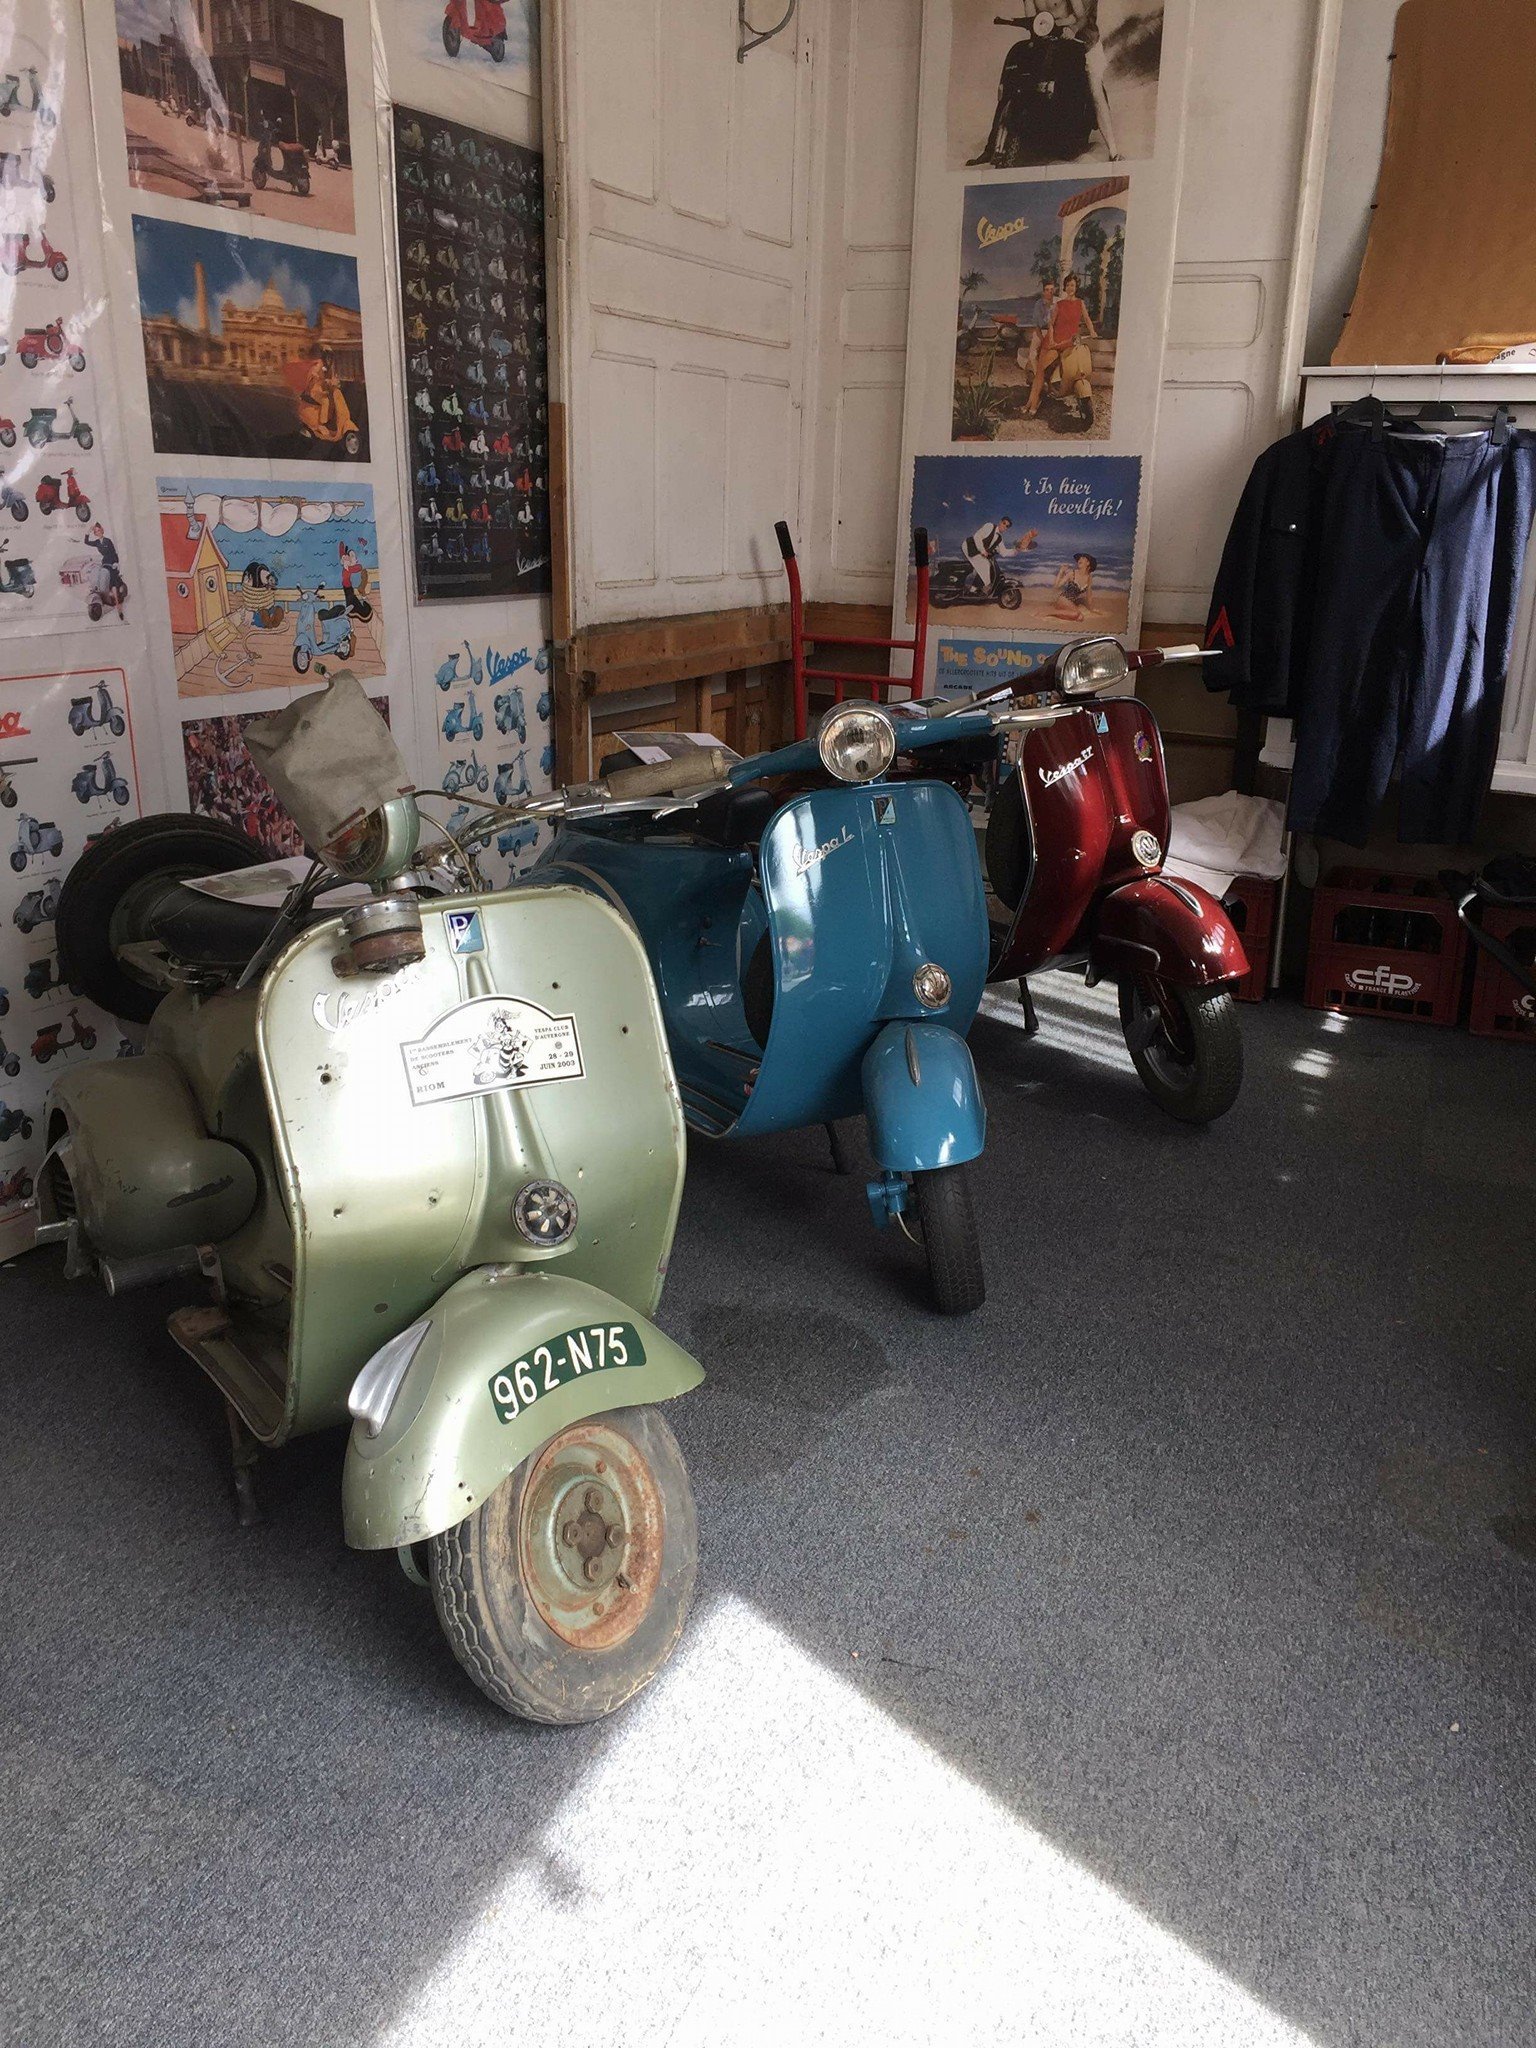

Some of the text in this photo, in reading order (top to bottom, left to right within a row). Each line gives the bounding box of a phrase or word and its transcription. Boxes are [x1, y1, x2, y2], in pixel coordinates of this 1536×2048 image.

[976, 216, 1029, 249] Vespa
[1059, 477, 1092, 495] hier
[1048, 497, 1123, 520] heerlijk!
[486, 645, 533, 687] Vespa
[940, 646, 968, 667] THE
[973, 646, 1033, 668] SOUND
[1038, 758, 1083, 788] Vespa
[792, 838, 843, 876] Vespa
[540, 1059, 576, 1070] JUIN 2003
[548, 1052, 558, 1060] 28
[416, 1081, 445, 1093] RIOM
[494, 1326, 628, 1420] 962-N75
